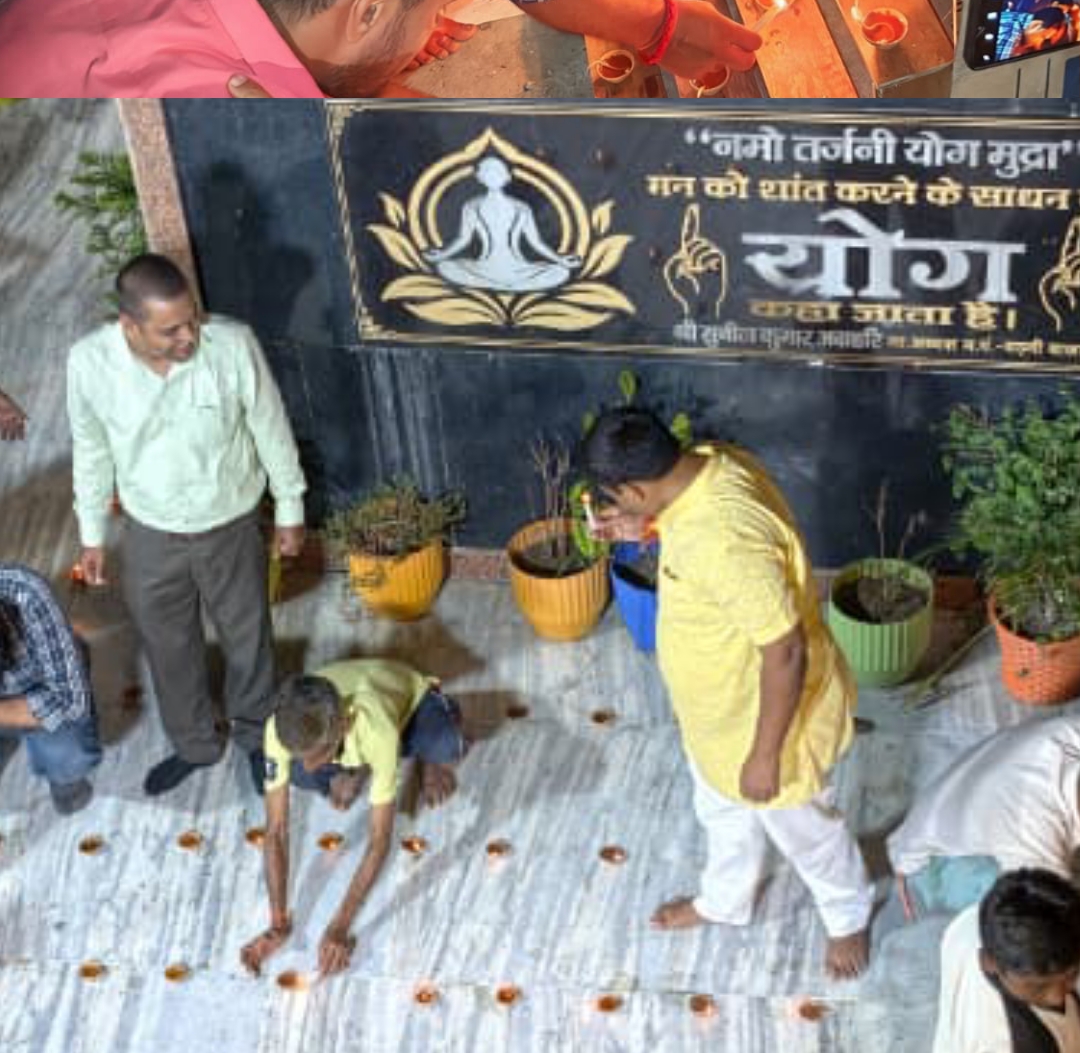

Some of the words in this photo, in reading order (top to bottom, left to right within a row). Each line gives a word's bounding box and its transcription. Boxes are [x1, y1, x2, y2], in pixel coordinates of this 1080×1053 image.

[791, 126, 899, 164] तर्जनी
[903, 130, 982, 168] योग
[647, 175, 697, 198] मन
[701, 169, 749, 199] को
[758, 172, 828, 201] शांत
[833, 174, 918, 205] करने
[926, 176, 963, 206] के
[970, 184, 1073, 211] साधन
[741, 207, 1026, 303] योग
[852, 303, 957, 326] जाता
